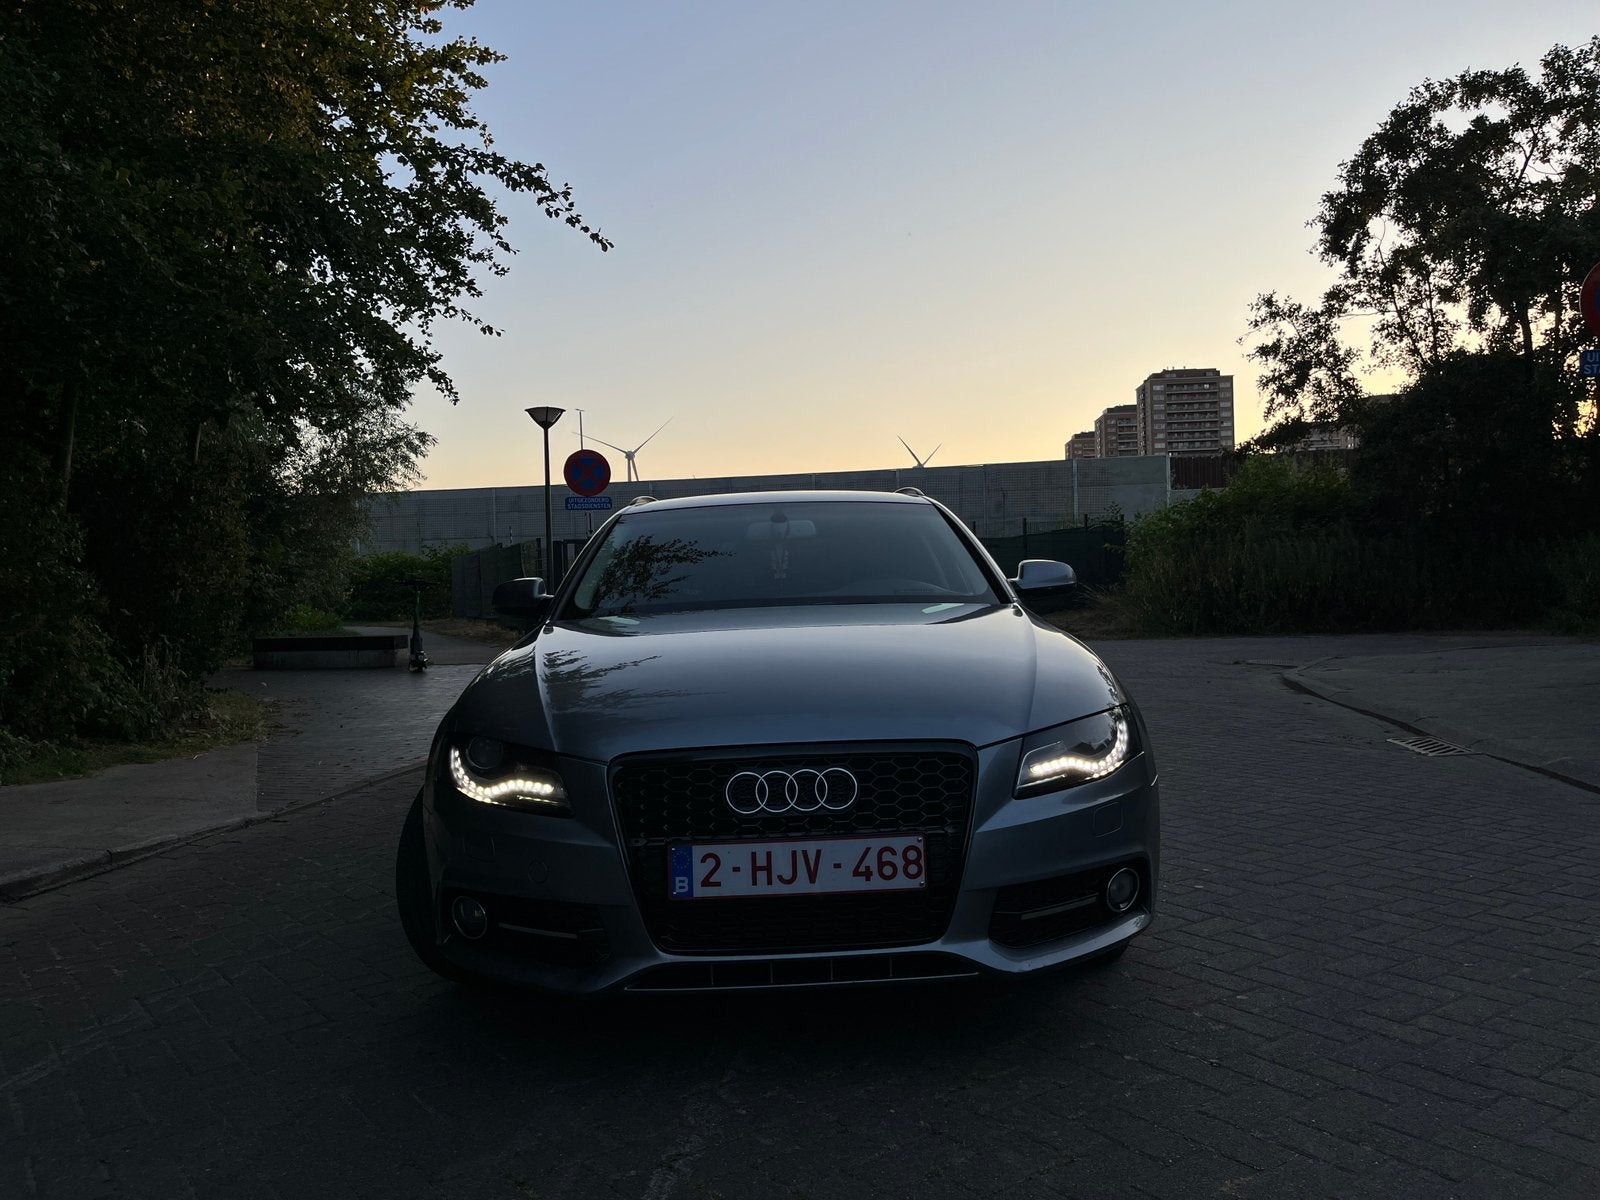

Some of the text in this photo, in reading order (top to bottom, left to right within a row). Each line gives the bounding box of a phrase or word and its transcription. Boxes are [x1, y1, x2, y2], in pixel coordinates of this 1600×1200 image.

[1587, 352, 1600, 362] UI
[700, 845, 923, 888] 2-HJV-468
[674, 876, 689, 892] B
